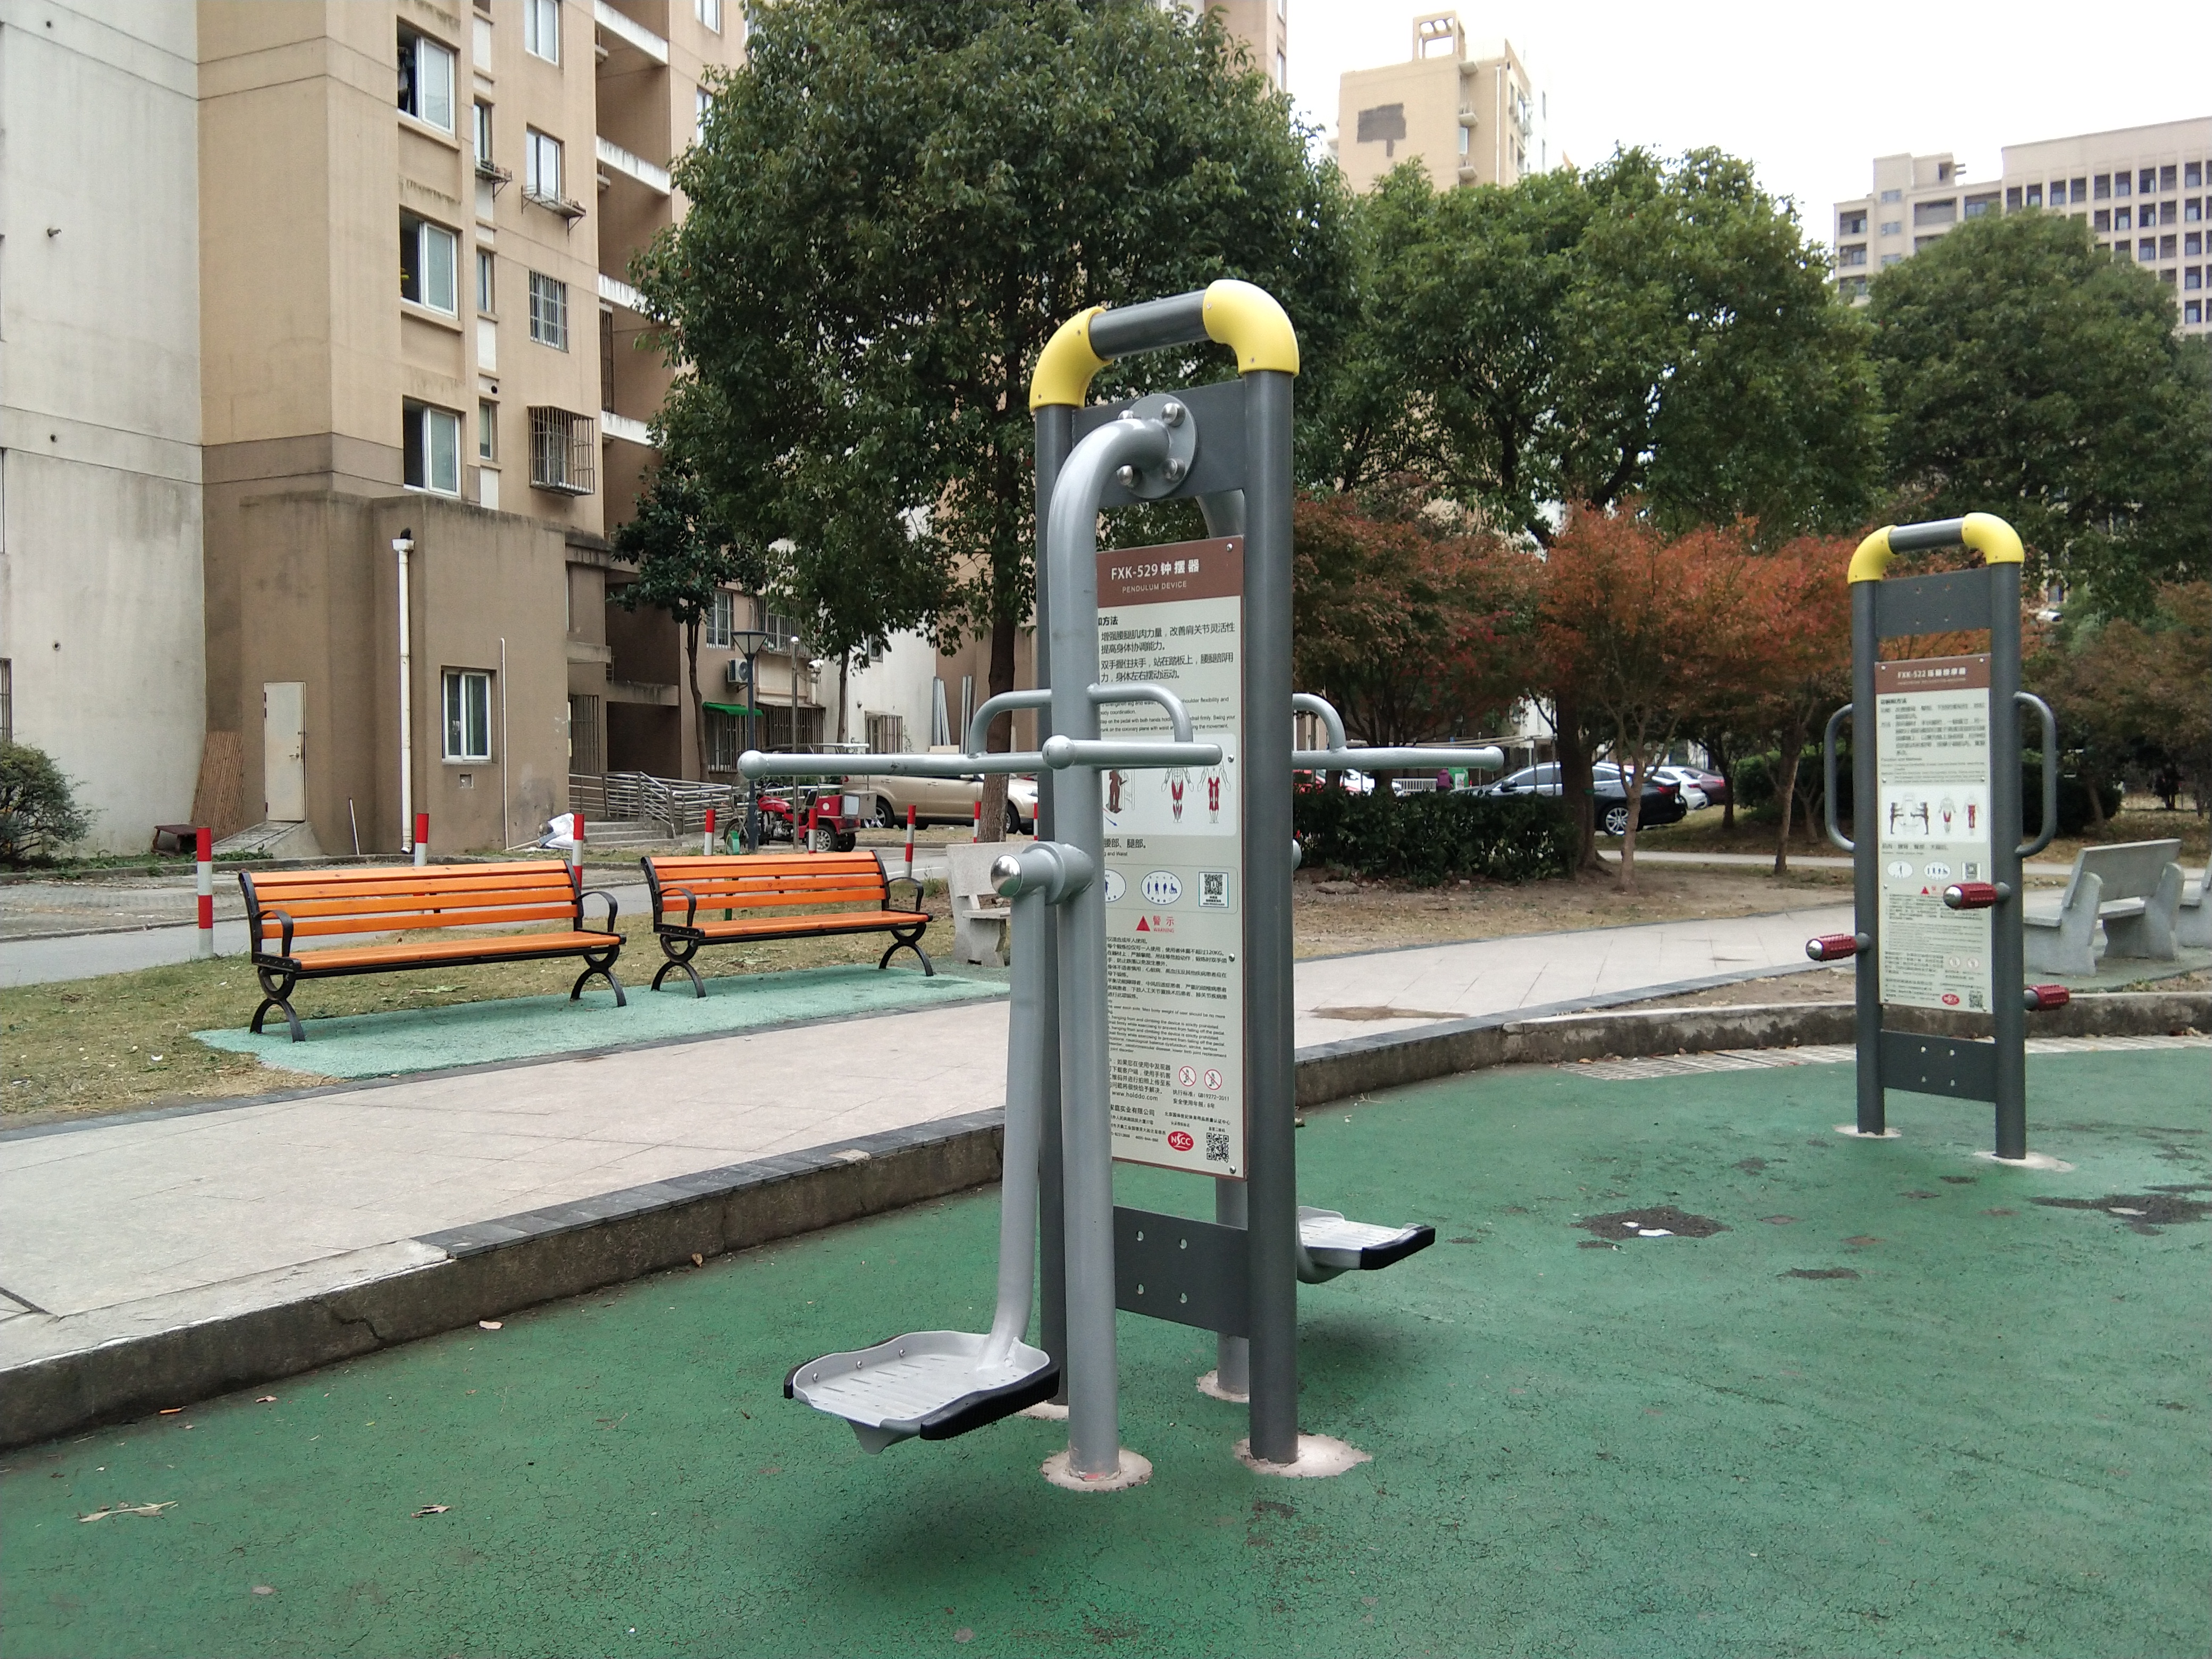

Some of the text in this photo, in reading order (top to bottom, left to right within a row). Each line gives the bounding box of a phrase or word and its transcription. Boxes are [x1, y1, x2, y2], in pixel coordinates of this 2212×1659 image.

[1111, 559, 1200, 580] FXK-529 钟摆器
[1122, 580, 1187, 593] PENDULUM DEVICE
[1153, 915, 1175, 927] 警示
[1112, 1091, 1158, 1101] www.holddo.com
